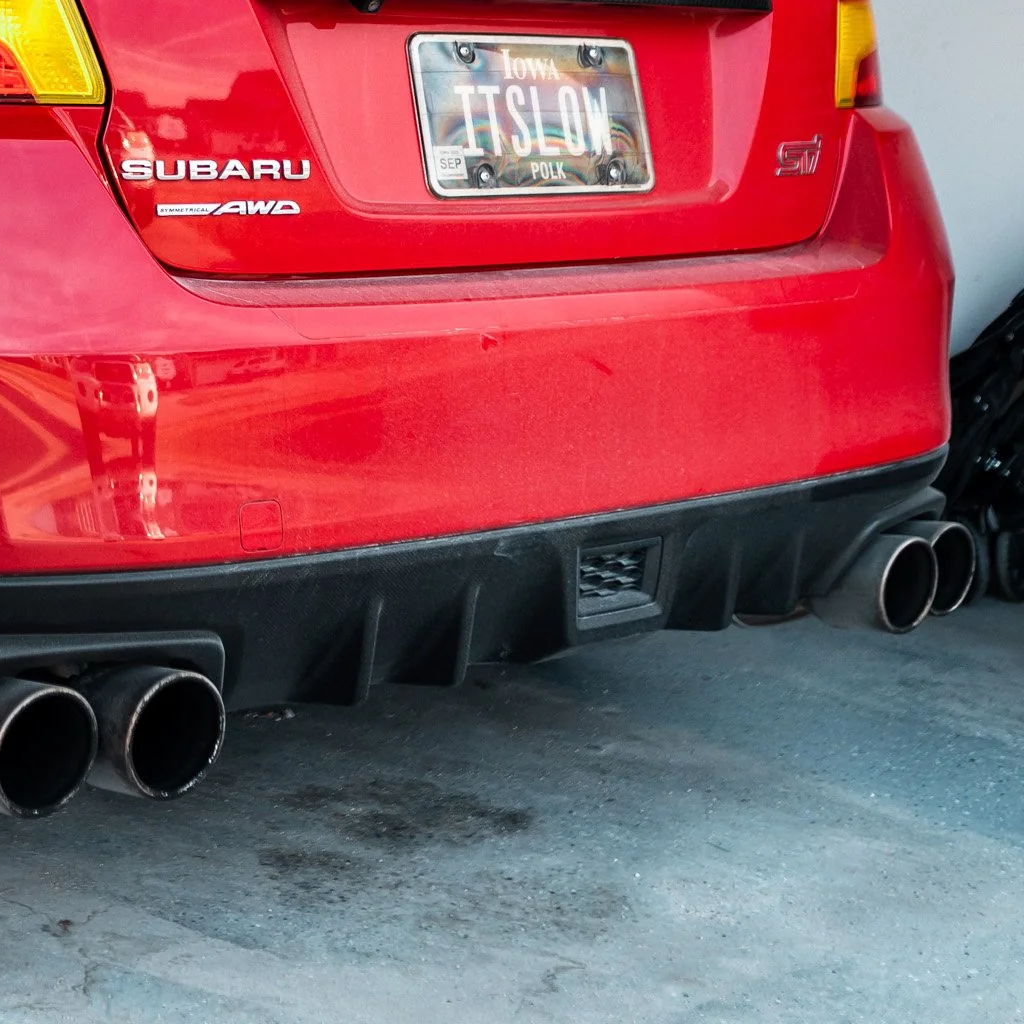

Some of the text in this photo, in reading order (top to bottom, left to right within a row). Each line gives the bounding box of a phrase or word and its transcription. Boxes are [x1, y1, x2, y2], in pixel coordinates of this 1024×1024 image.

[454, 85, 613, 157] ITSLOW
[121, 159, 311, 181] SUBARU
[439, 157, 462, 170] SEP
[531, 162, 567, 181] POLK
[213, 200, 301, 216] AWD
